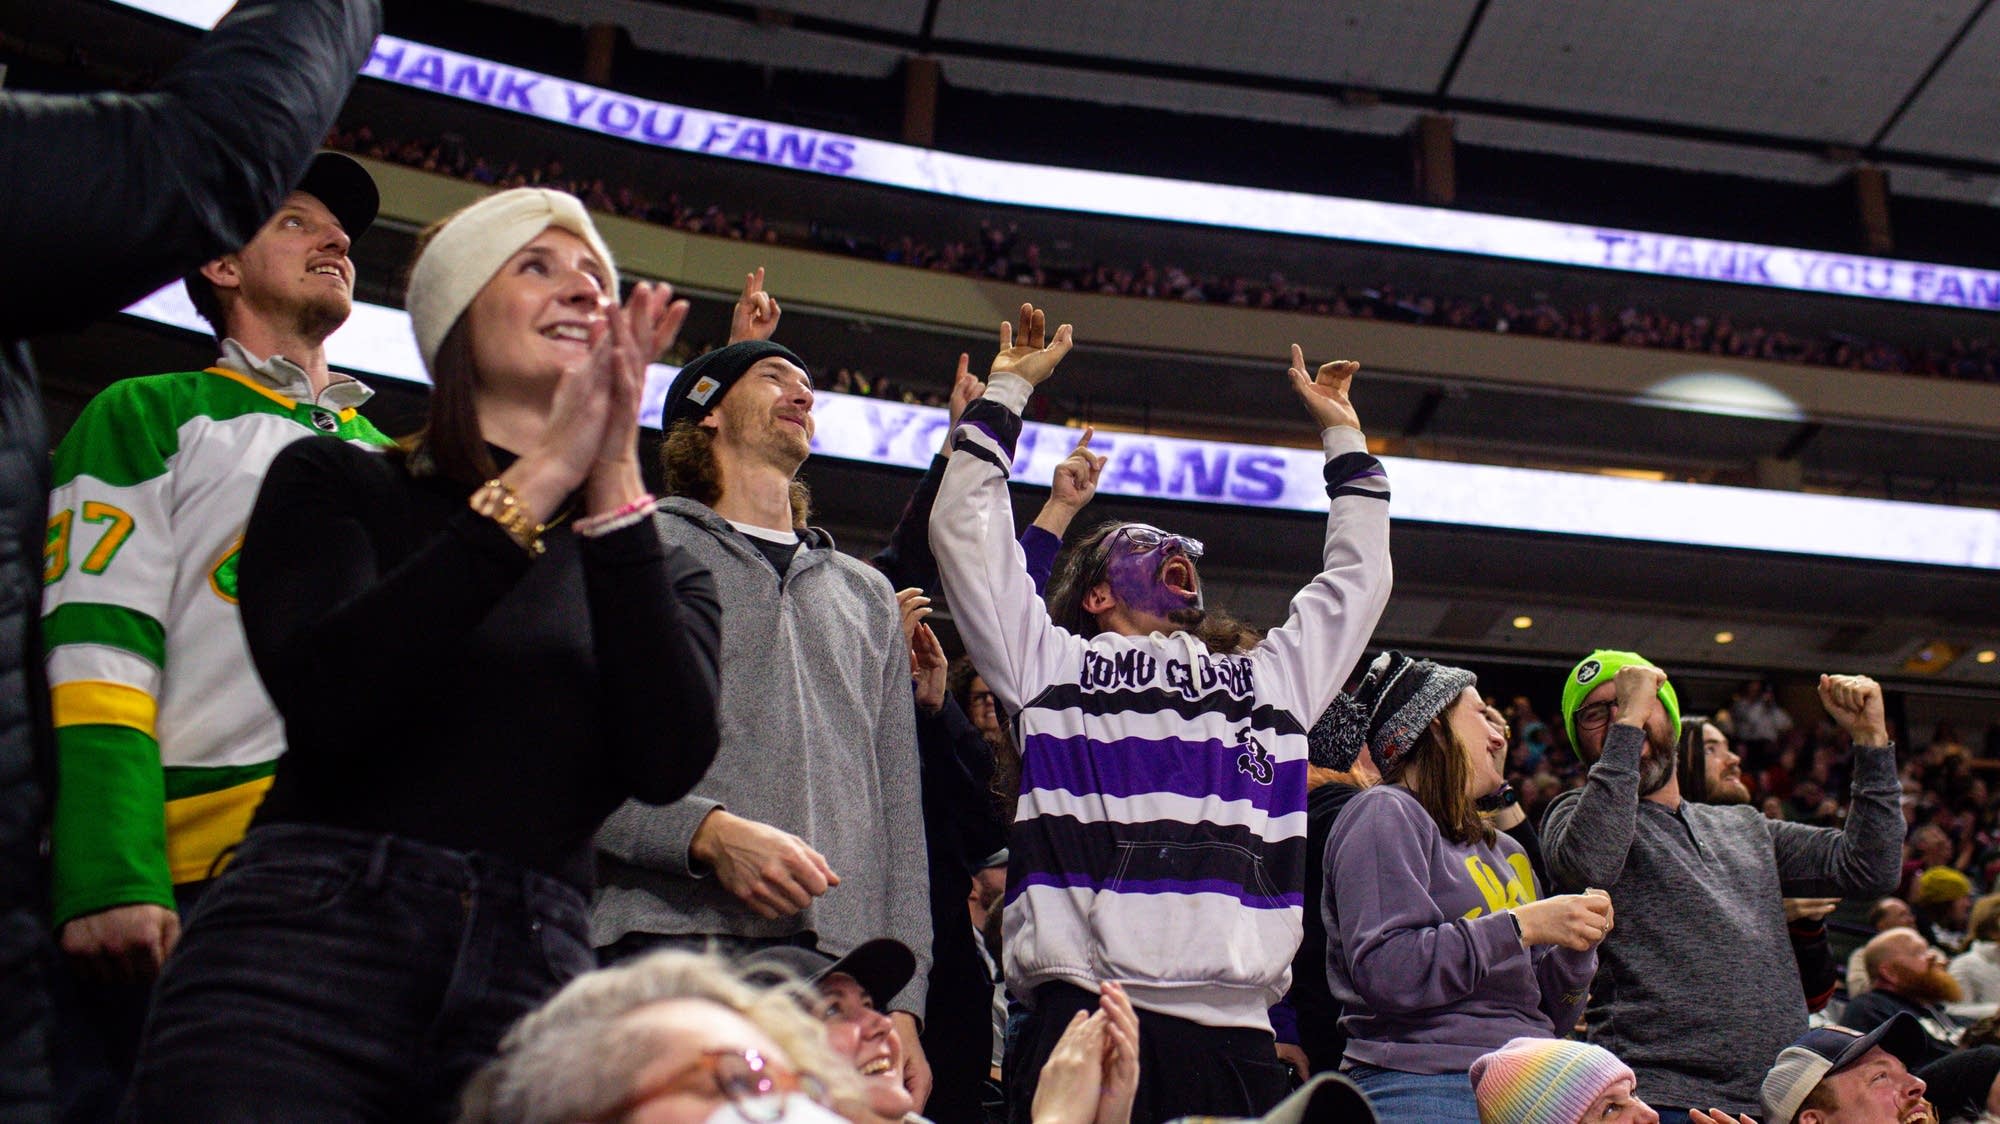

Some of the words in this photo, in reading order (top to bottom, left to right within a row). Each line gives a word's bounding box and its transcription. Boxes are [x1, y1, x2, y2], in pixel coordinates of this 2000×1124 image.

[363, 47, 540, 114] HANK
[564, 87, 684, 141] YOU
[701, 121, 855, 173] FANS
[1594, 234, 1774, 284] THANK
[1795, 257, 1894, 295] YOU
[1912, 269, 2000, 308] FAN
